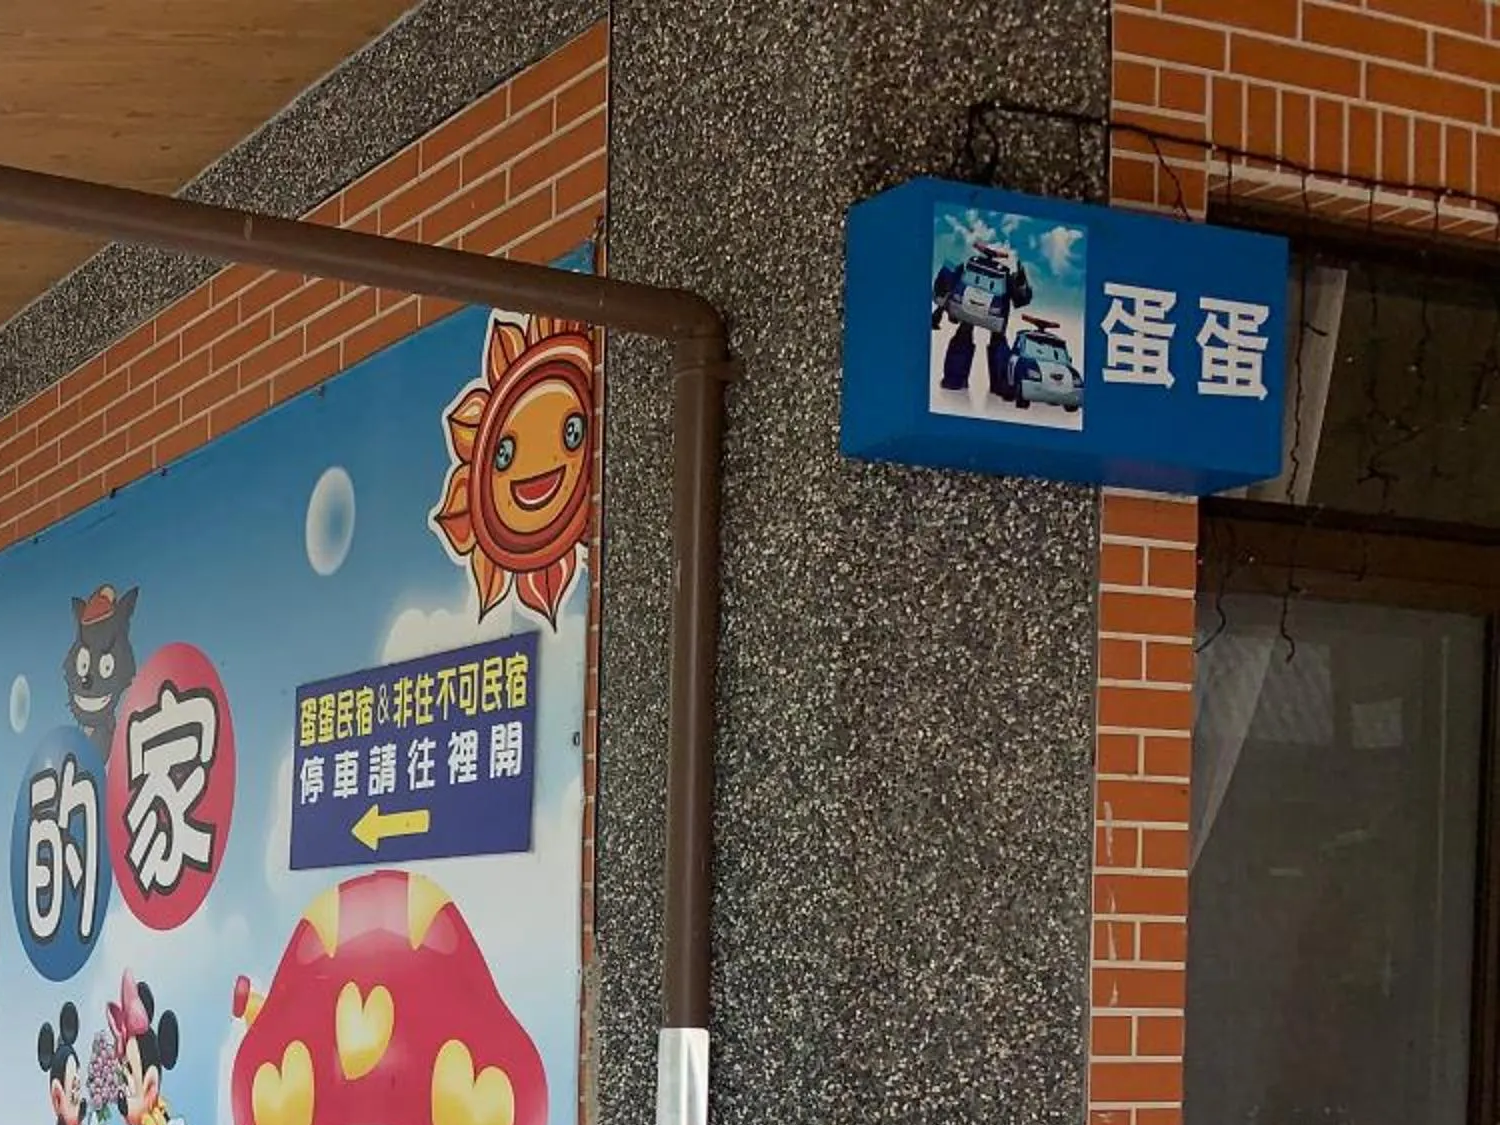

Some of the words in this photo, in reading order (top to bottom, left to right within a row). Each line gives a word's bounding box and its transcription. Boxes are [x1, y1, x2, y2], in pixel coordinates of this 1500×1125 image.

[1101, 282, 1270, 400] 蛋蛋
[300, 721, 523, 805] 停車請往裡開
